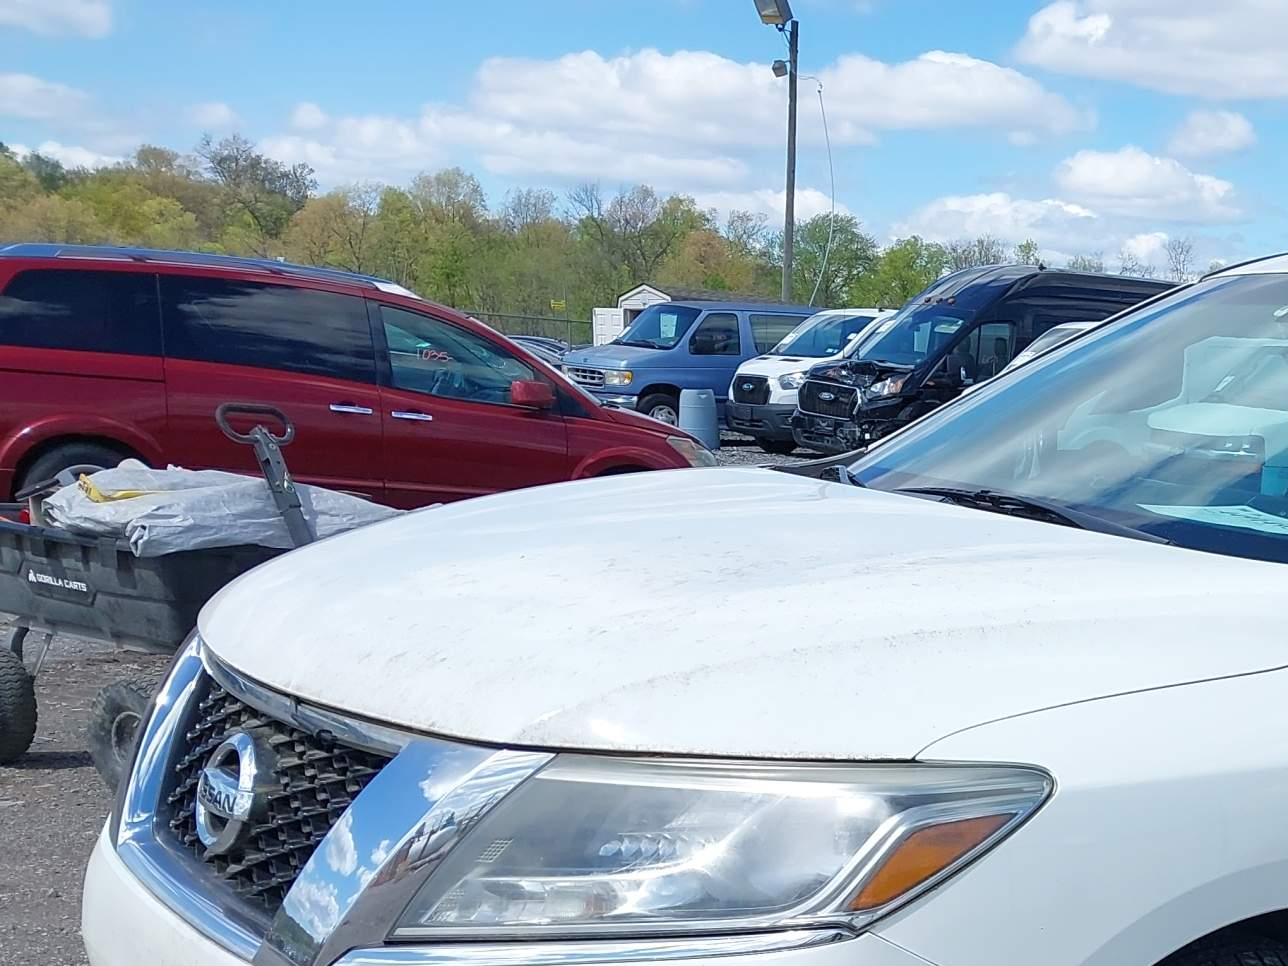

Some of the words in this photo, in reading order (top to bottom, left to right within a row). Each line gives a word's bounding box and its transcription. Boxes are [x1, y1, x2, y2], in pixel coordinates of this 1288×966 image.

[36, 573, 64, 587] GORILLA
[64, 579, 87, 592] CARTS
[201, 783, 238, 813] SSAN
